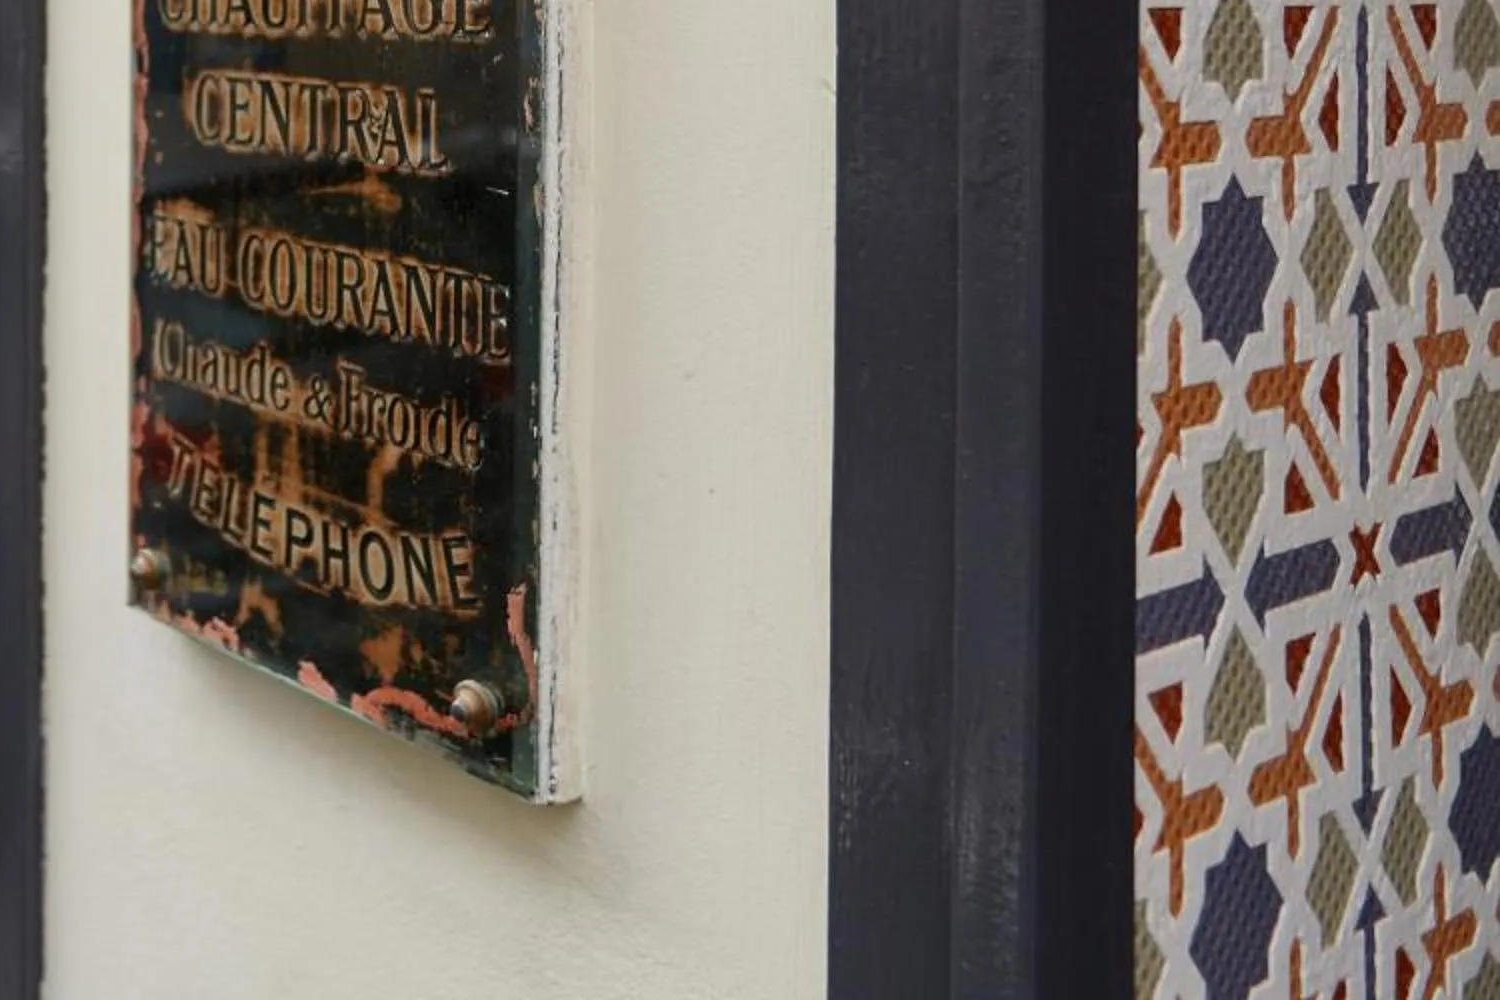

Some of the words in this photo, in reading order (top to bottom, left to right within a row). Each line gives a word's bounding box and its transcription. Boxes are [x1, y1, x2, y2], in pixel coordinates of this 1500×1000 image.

[194, 70, 456, 176] CENTRAL
[237, 231, 512, 365] COURANTE
[303, 374, 333, 424] &
